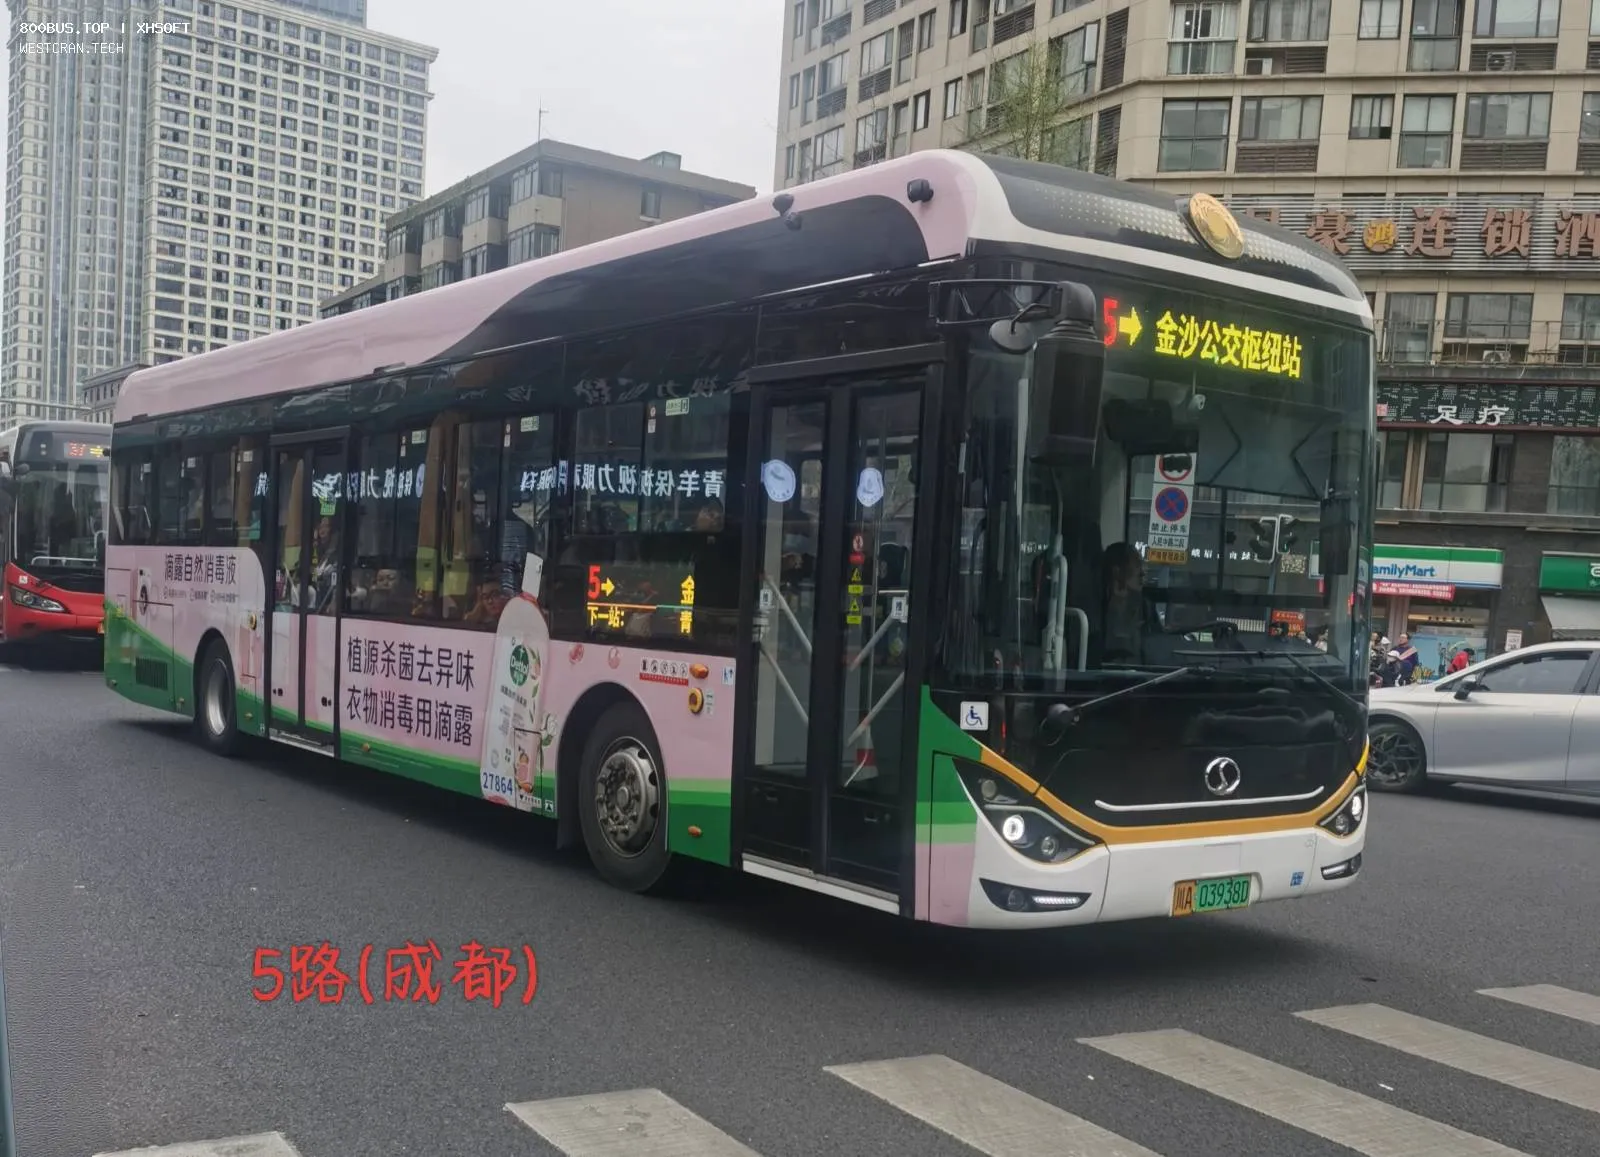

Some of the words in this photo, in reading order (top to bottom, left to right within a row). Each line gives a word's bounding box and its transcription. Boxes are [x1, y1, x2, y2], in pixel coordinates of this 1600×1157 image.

[1103, 297, 1118, 347] 5
[1155, 310, 1302, 378] 金沙公交枢纽站
[1430, 404, 1510, 426] 足疗
[1151, 522, 1187, 534] 禁止停车
[165, 554, 237, 585] 滴露自然消毒液
[587, 565, 600, 599] 5
[1372, 563, 1436, 578] amilyMart
[347, 635, 475, 692] 植源杀菌去异味
[346, 685, 473, 747] 衣物消毒用滴露
[483, 772, 513, 796] 27864
